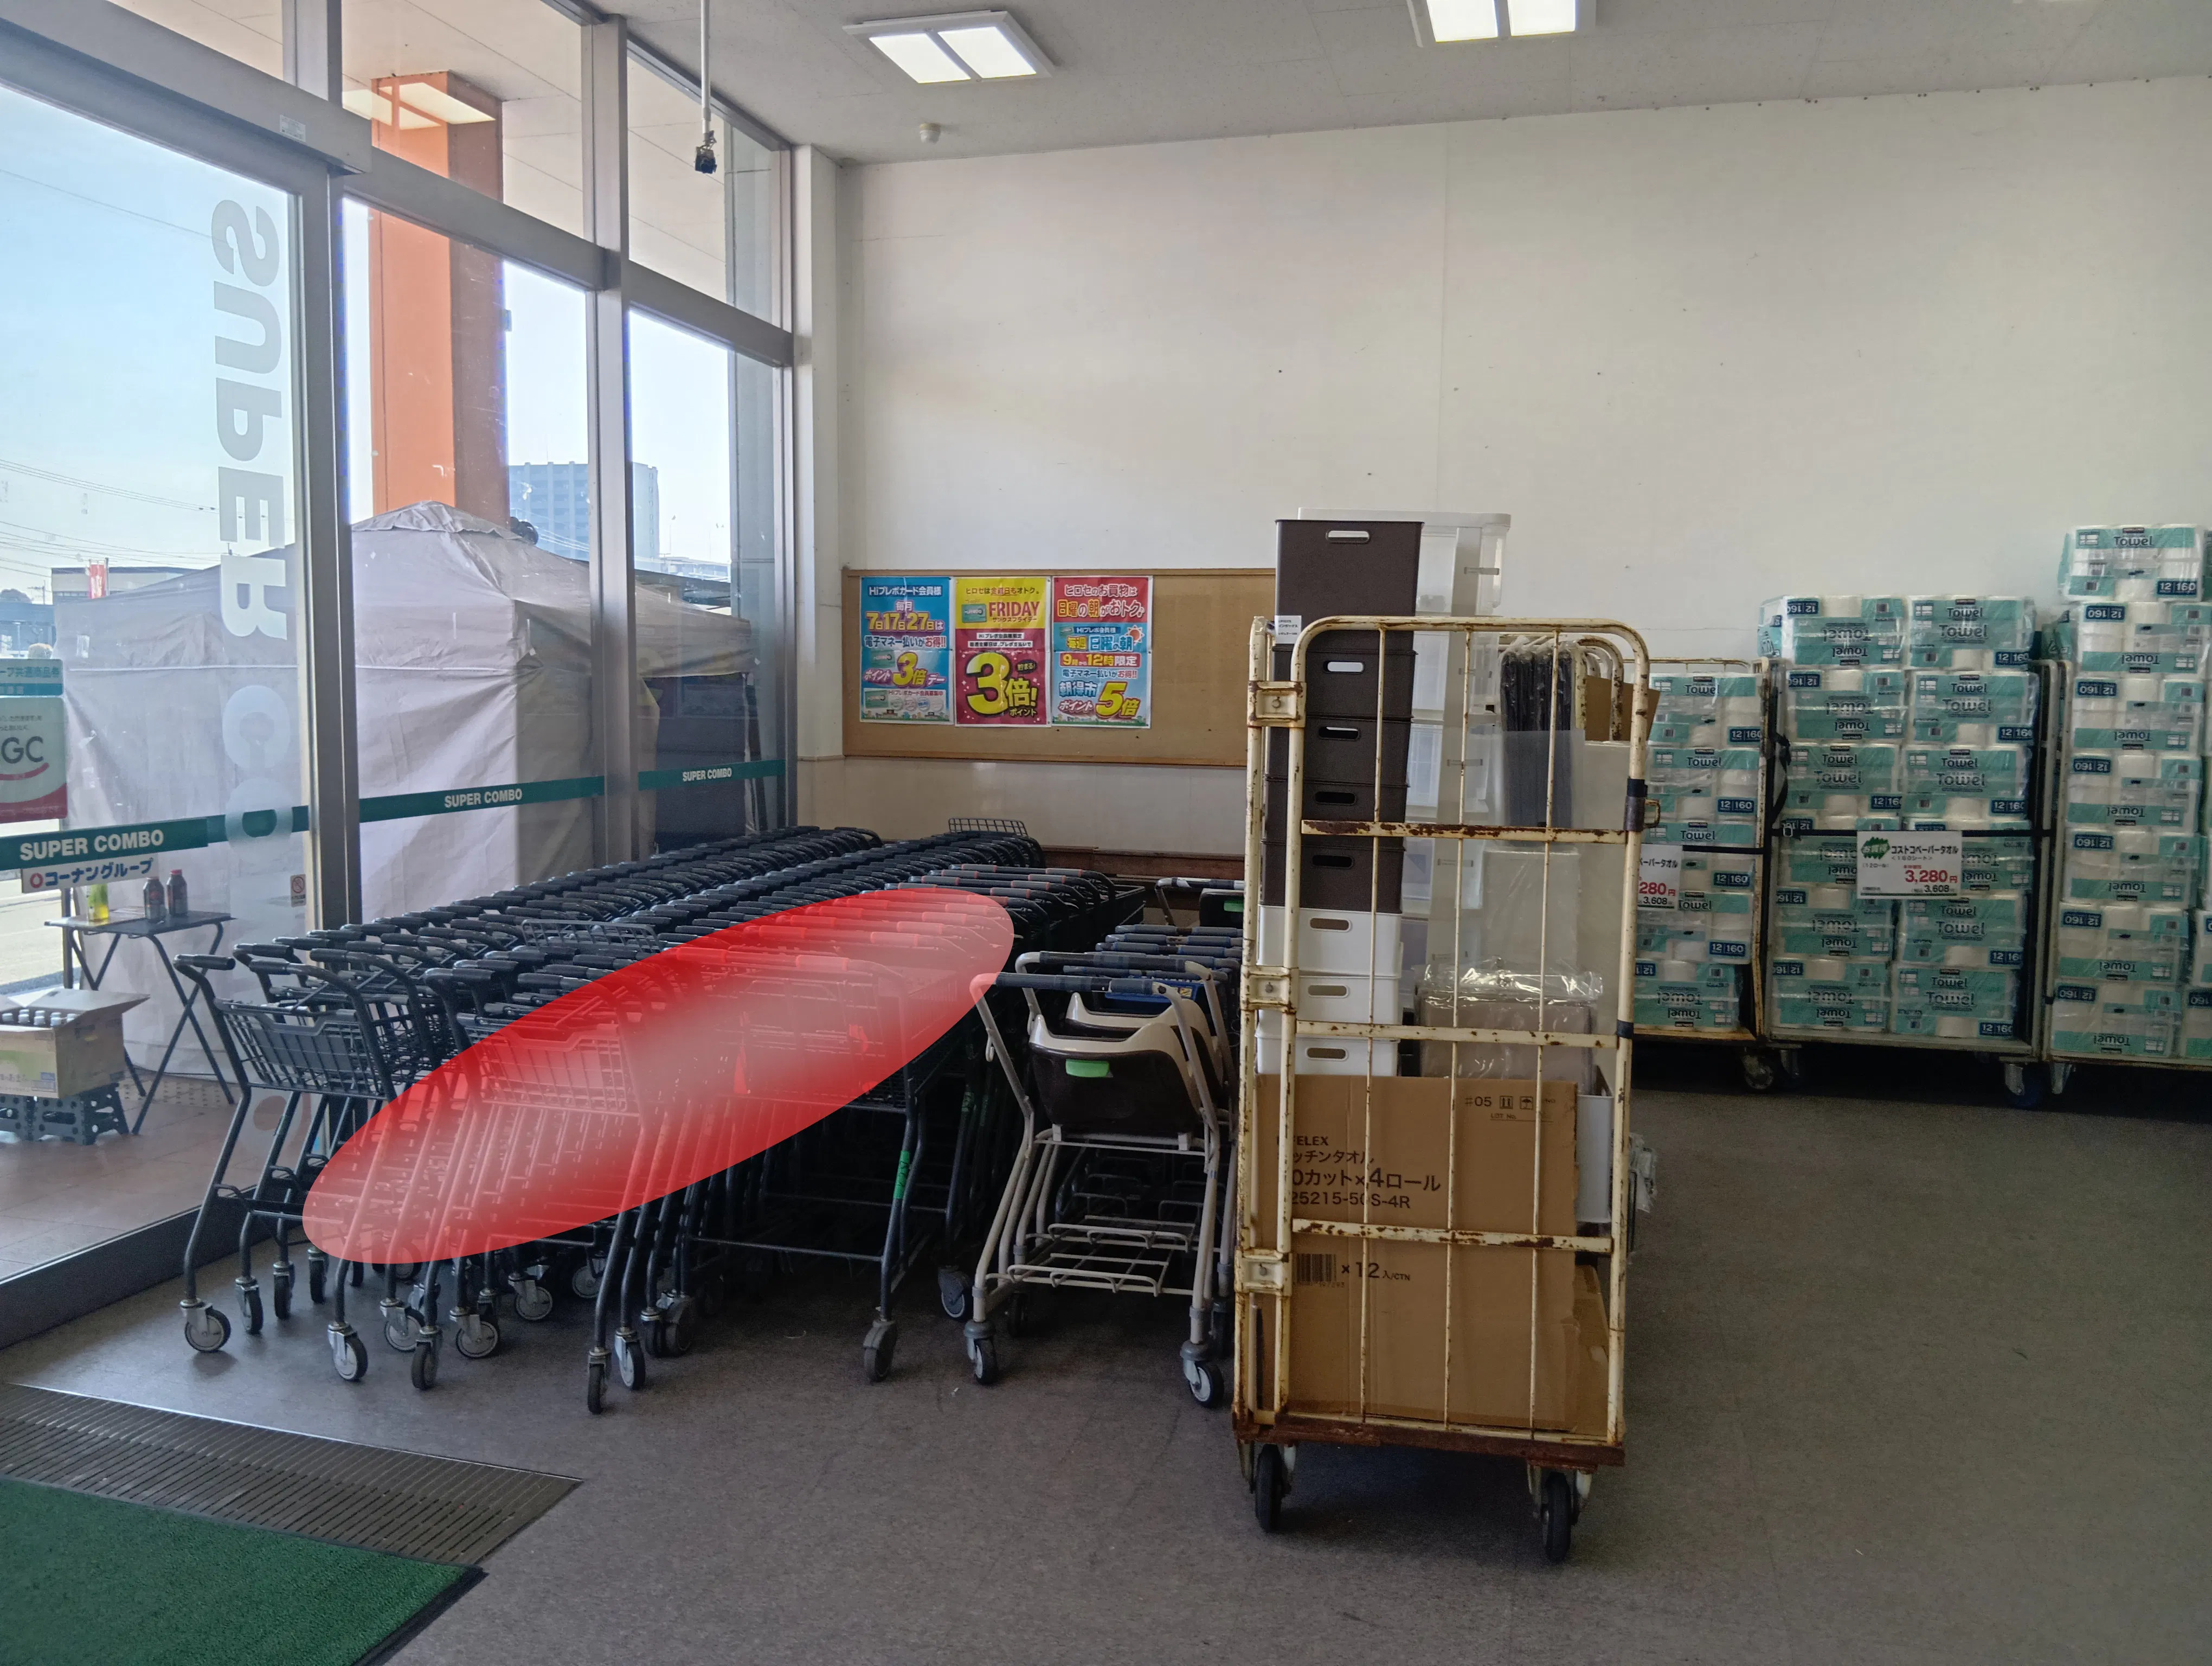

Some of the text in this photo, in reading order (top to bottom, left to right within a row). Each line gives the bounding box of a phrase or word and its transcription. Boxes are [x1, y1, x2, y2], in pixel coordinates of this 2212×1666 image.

[2113, 536, 2152, 546] Towel
[1065, 584, 1138, 597] ヒロセのお買物は
[896, 601, 912, 611] 毎月
[989, 601, 1040, 617] FRIDAY
[1946, 607, 1983, 618] Towel
[1939, 625, 1988, 639] Towel
[1059, 680, 1098, 697] 朝得市
[1685, 683, 1720, 695] Towel
[1952, 682, 1988, 693] Towel
[1942, 699, 1992, 712] Towel
[1009, 708, 1037, 716] ポイント
[1732, 731, 1741, 739] 12
[1686, 757, 1722, 767] Towel
[1822, 754, 1857, 765] Towel
[1941, 758, 1978, 767] Towel
[682, 767, 732, 782] SUPER COMBO
[1937, 773, 1985, 786] Towel
[444, 787, 523, 808] SUPER COMBO
[1681, 830, 1715, 841] Towel
[20, 829, 164, 861] SUPER COMBO
[1891, 845, 1959, 854] コストコペーパータオル
[45, 857, 154, 887] コーナングループ
[1828, 867, 1857, 876] owel
[1905, 869, 1958, 883] 3,280円
[1731, 874, 1748, 883] 160
[1638, 881, 1676, 896] 280円
[1677, 900, 1711, 910] Towel
[1941, 906, 1976, 917] Towel
[1935, 921, 1985, 935] Towel
[1726, 944, 1744, 952] 160
[1993, 952, 2004, 960] 12
[1931, 977, 1968, 987] Towel
[1668, 1008, 1701, 1020] Towel
[1277, 1136, 1328, 1146] ELEX
[1278, 1150, 1374, 1164] ッチンタオル
[1293, 1167, 1441, 1191] 0カット×4ロール
